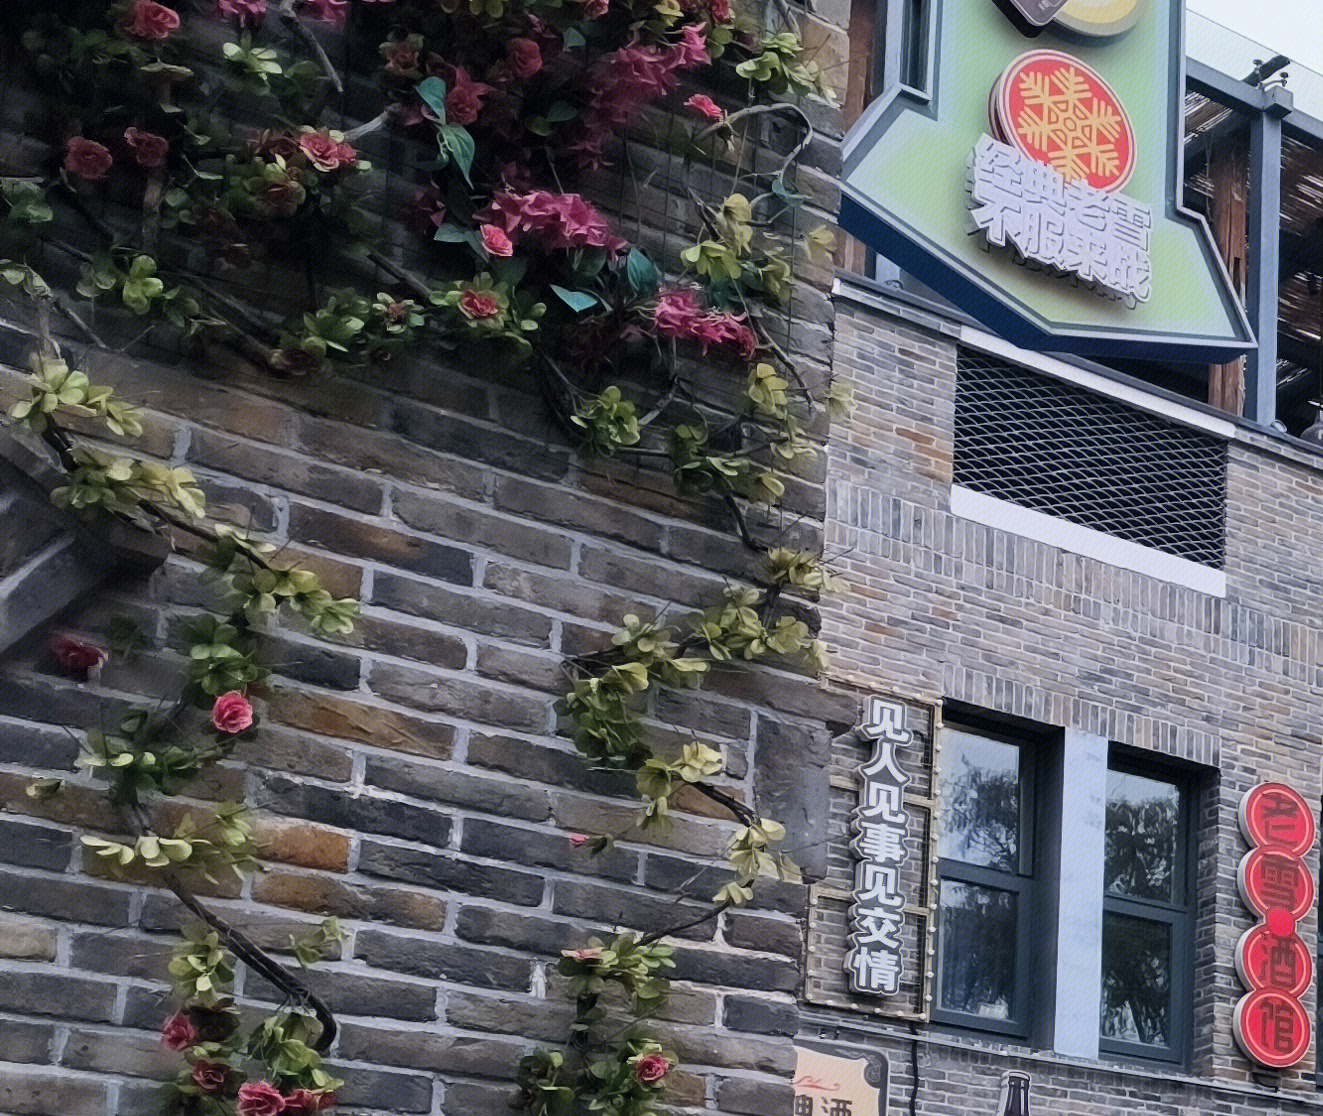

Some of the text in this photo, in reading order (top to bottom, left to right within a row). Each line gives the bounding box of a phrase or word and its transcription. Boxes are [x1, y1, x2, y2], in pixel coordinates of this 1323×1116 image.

[975, 133, 1152, 252] 经典老雪
[853, 698, 909, 991] 见人见事见交情
[1259, 792, 1300, 1053] 老雪酒馆
